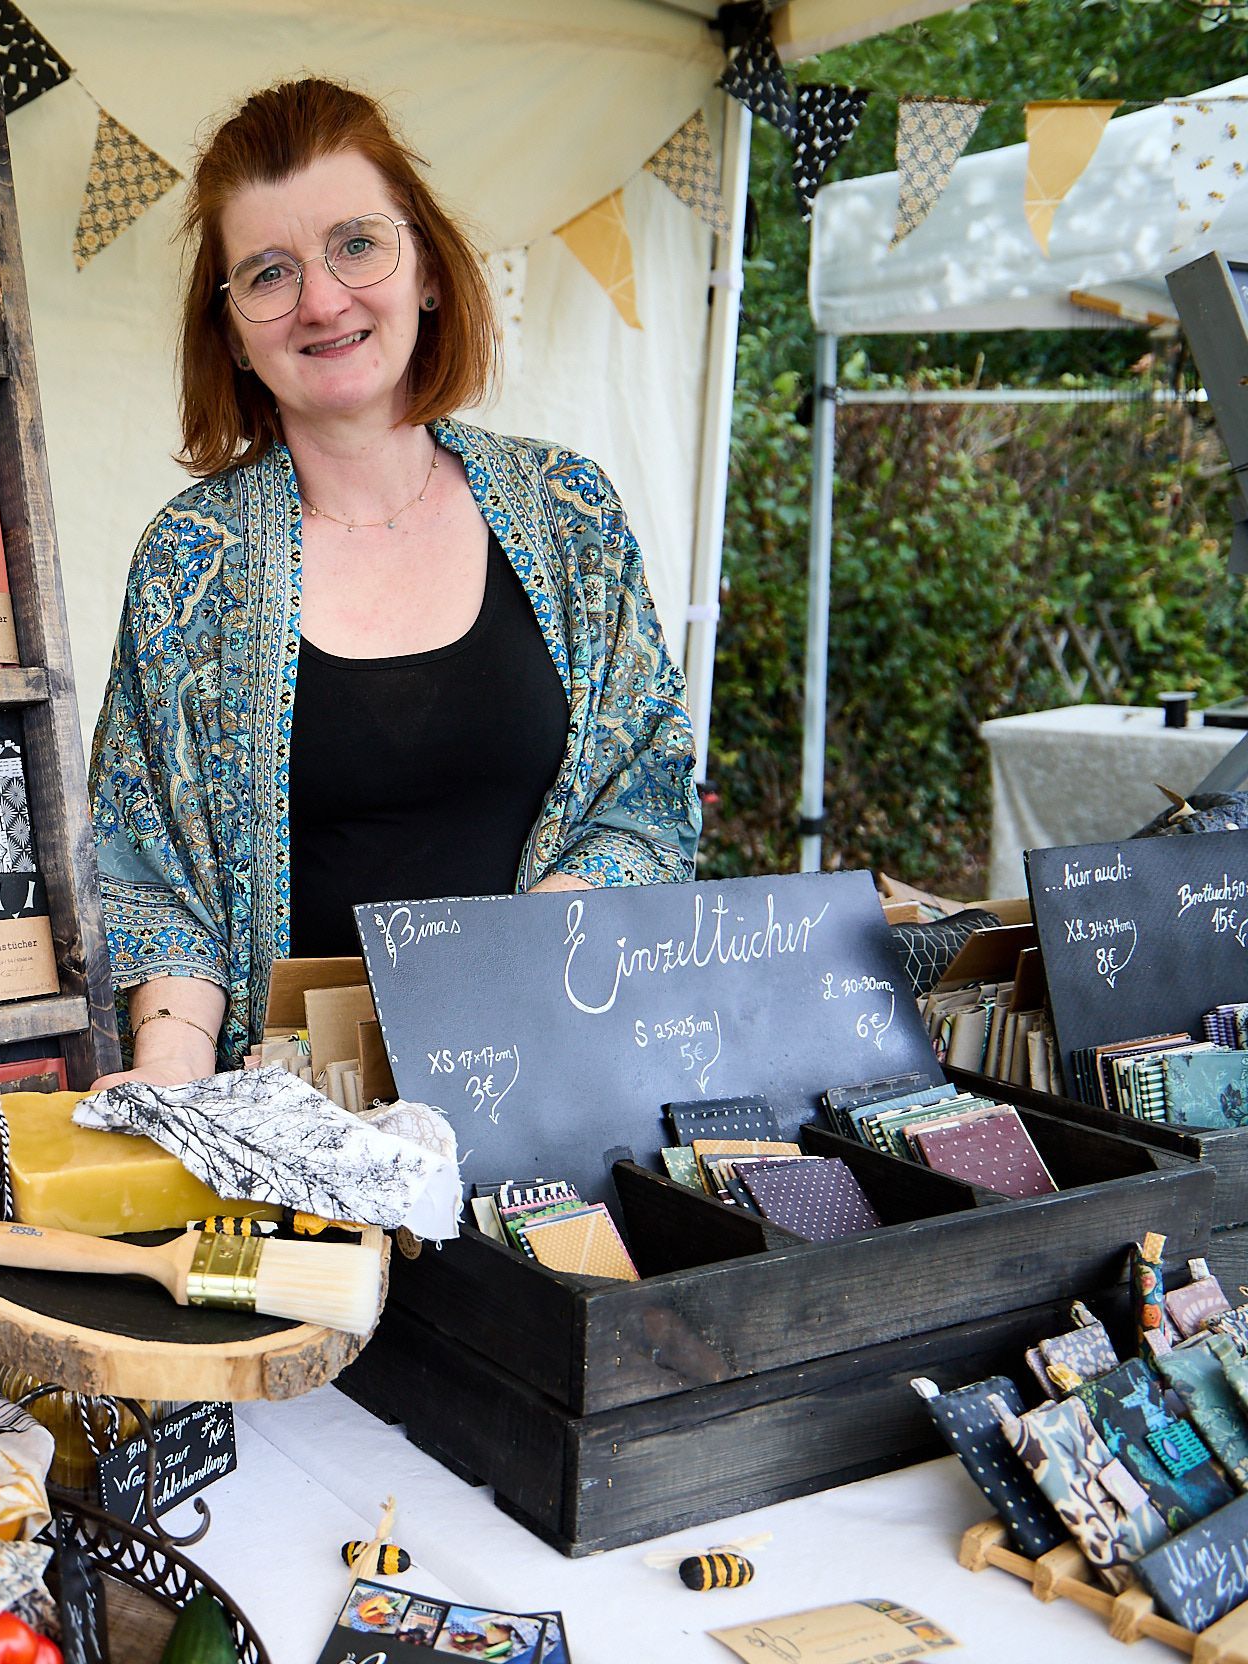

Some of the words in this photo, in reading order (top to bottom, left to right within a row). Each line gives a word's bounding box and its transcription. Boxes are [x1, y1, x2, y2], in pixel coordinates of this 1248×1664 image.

[1211, 907, 1238, 933] 15€
[563, 893, 830, 1015] Einzeltücher
[1096, 948, 1118, 975] 8€
[634, 1019, 649, 1048] S
[856, 1012, 885, 1038] 6€
[427, 1049, 456, 1075] XS
[680, 1042, 707, 1070] 5€
[465, 1075, 500, 1112] 3€
